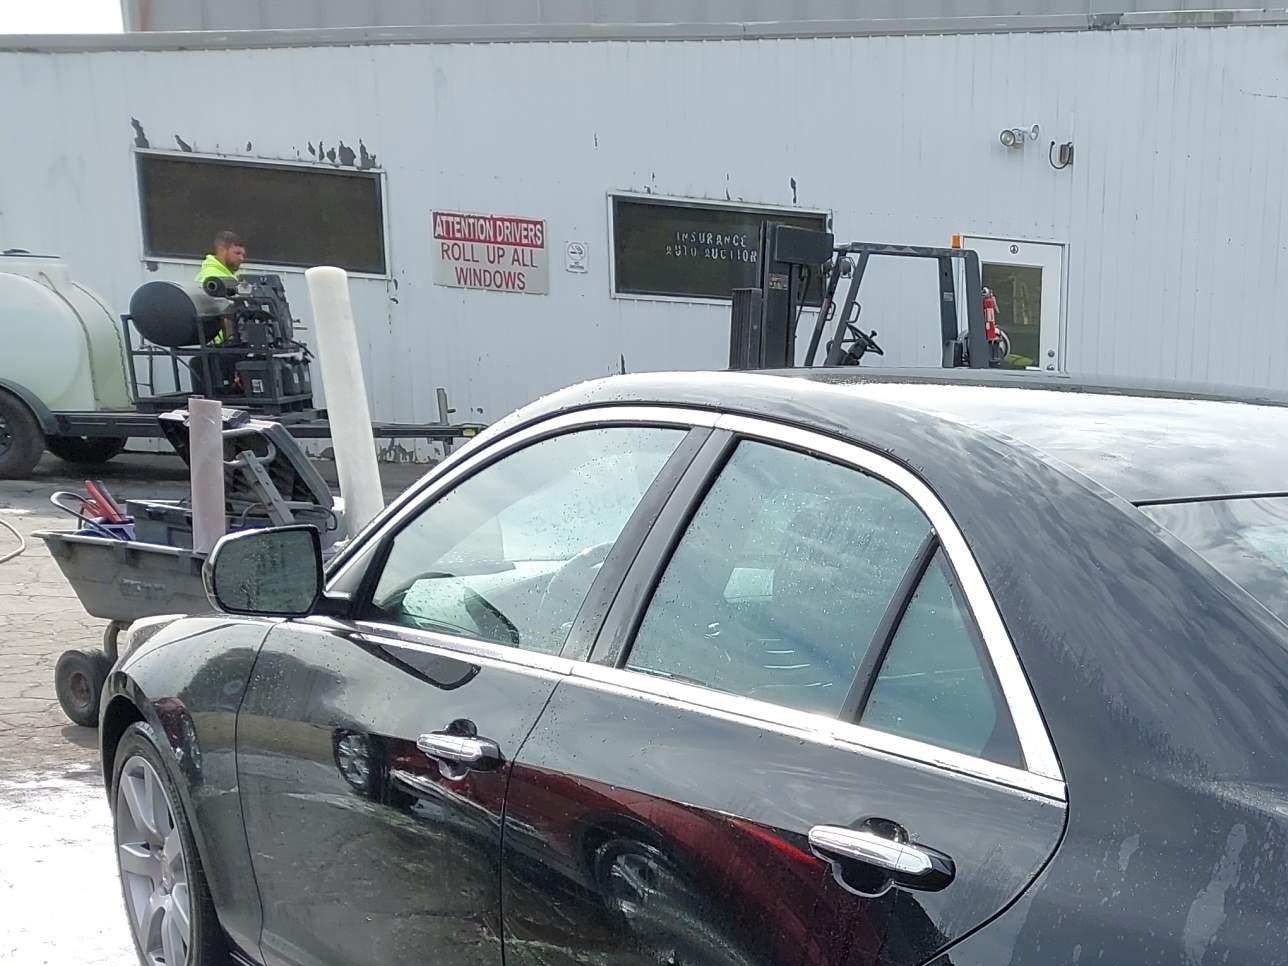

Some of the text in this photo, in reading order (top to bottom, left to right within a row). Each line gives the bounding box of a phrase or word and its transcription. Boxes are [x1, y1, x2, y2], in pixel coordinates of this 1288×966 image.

[434, 214, 543, 245] ATTENTION DRIVERS
[676, 231, 748, 248] INSURANCE
[441, 242, 538, 268] ROLL UP ALL
[666, 245, 697, 257] AUTO
[455, 266, 526, 290] WINDOWS
